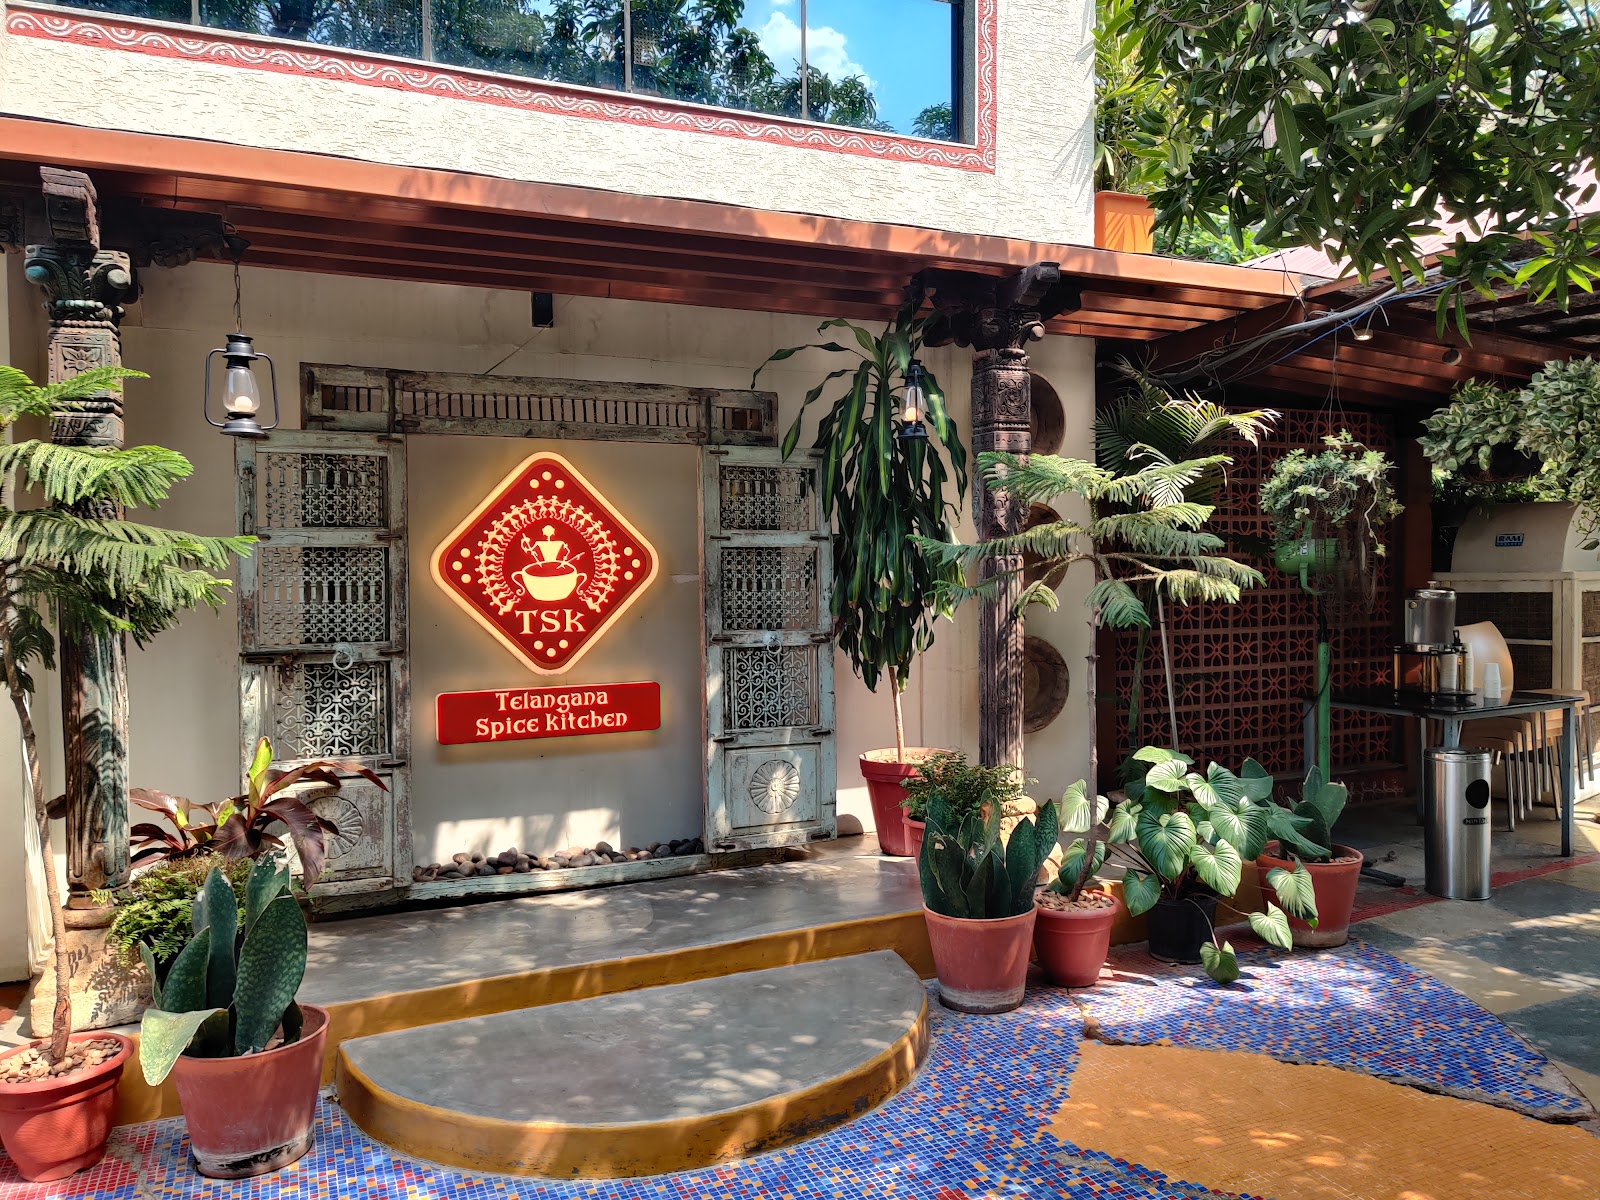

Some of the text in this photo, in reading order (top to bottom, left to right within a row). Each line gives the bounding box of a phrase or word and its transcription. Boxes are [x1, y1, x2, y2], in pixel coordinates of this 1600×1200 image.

[514, 608, 586, 634] TSK
[495, 690, 608, 713] Telangana
[476, 710, 628, 740] Spice Kitchen
